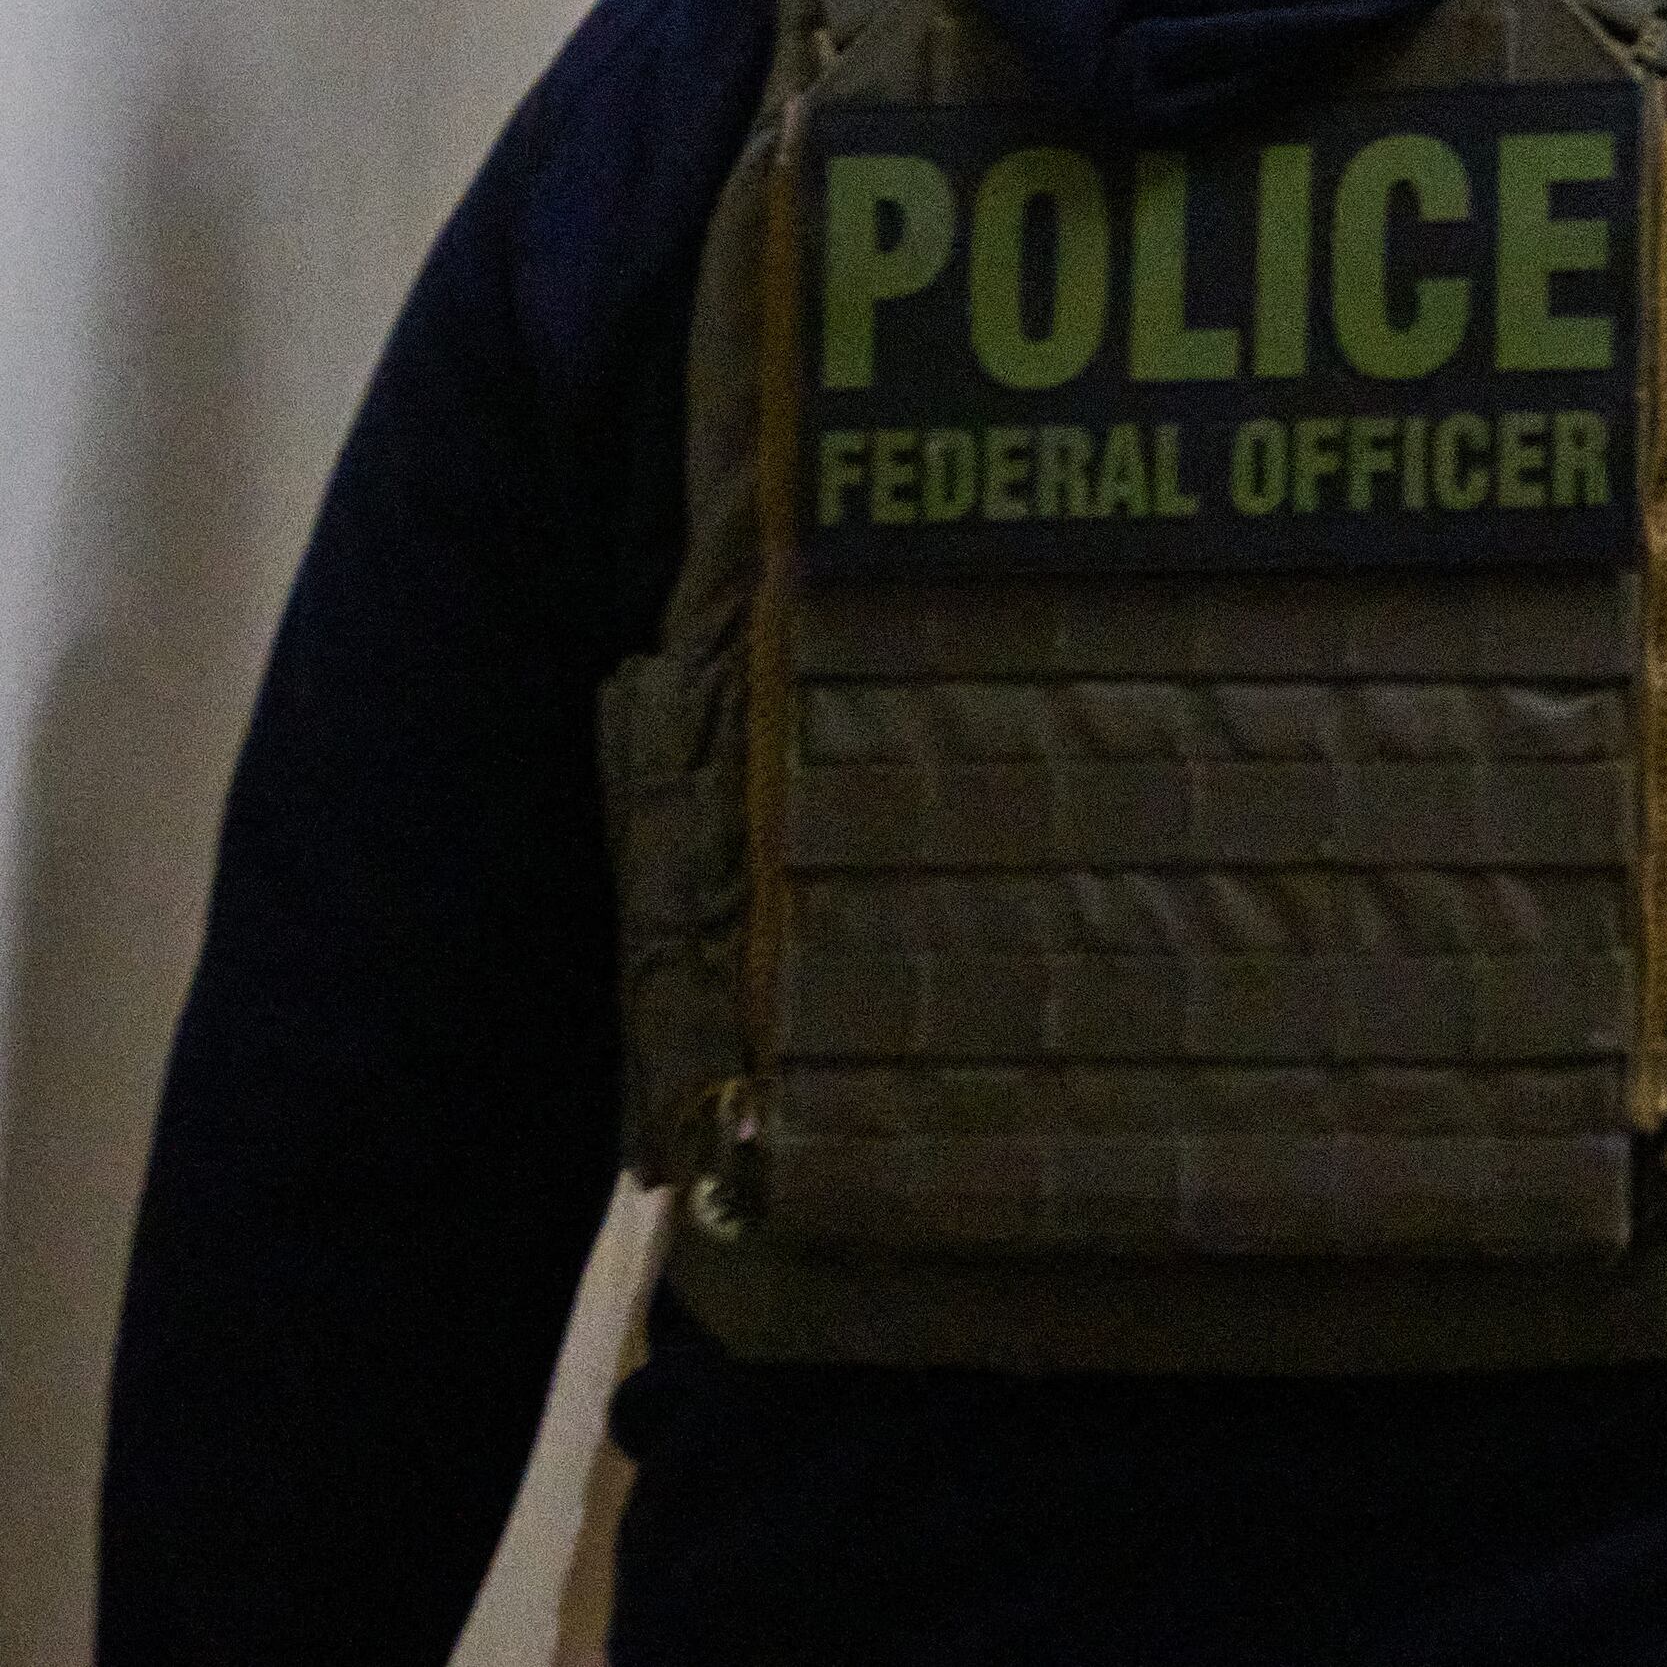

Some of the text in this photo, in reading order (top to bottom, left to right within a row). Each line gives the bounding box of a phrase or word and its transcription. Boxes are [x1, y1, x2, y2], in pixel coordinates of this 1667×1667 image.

[821, 132, 1615, 390] POLICE
[816, 410, 1611, 526] FEDERAL OFFICER
